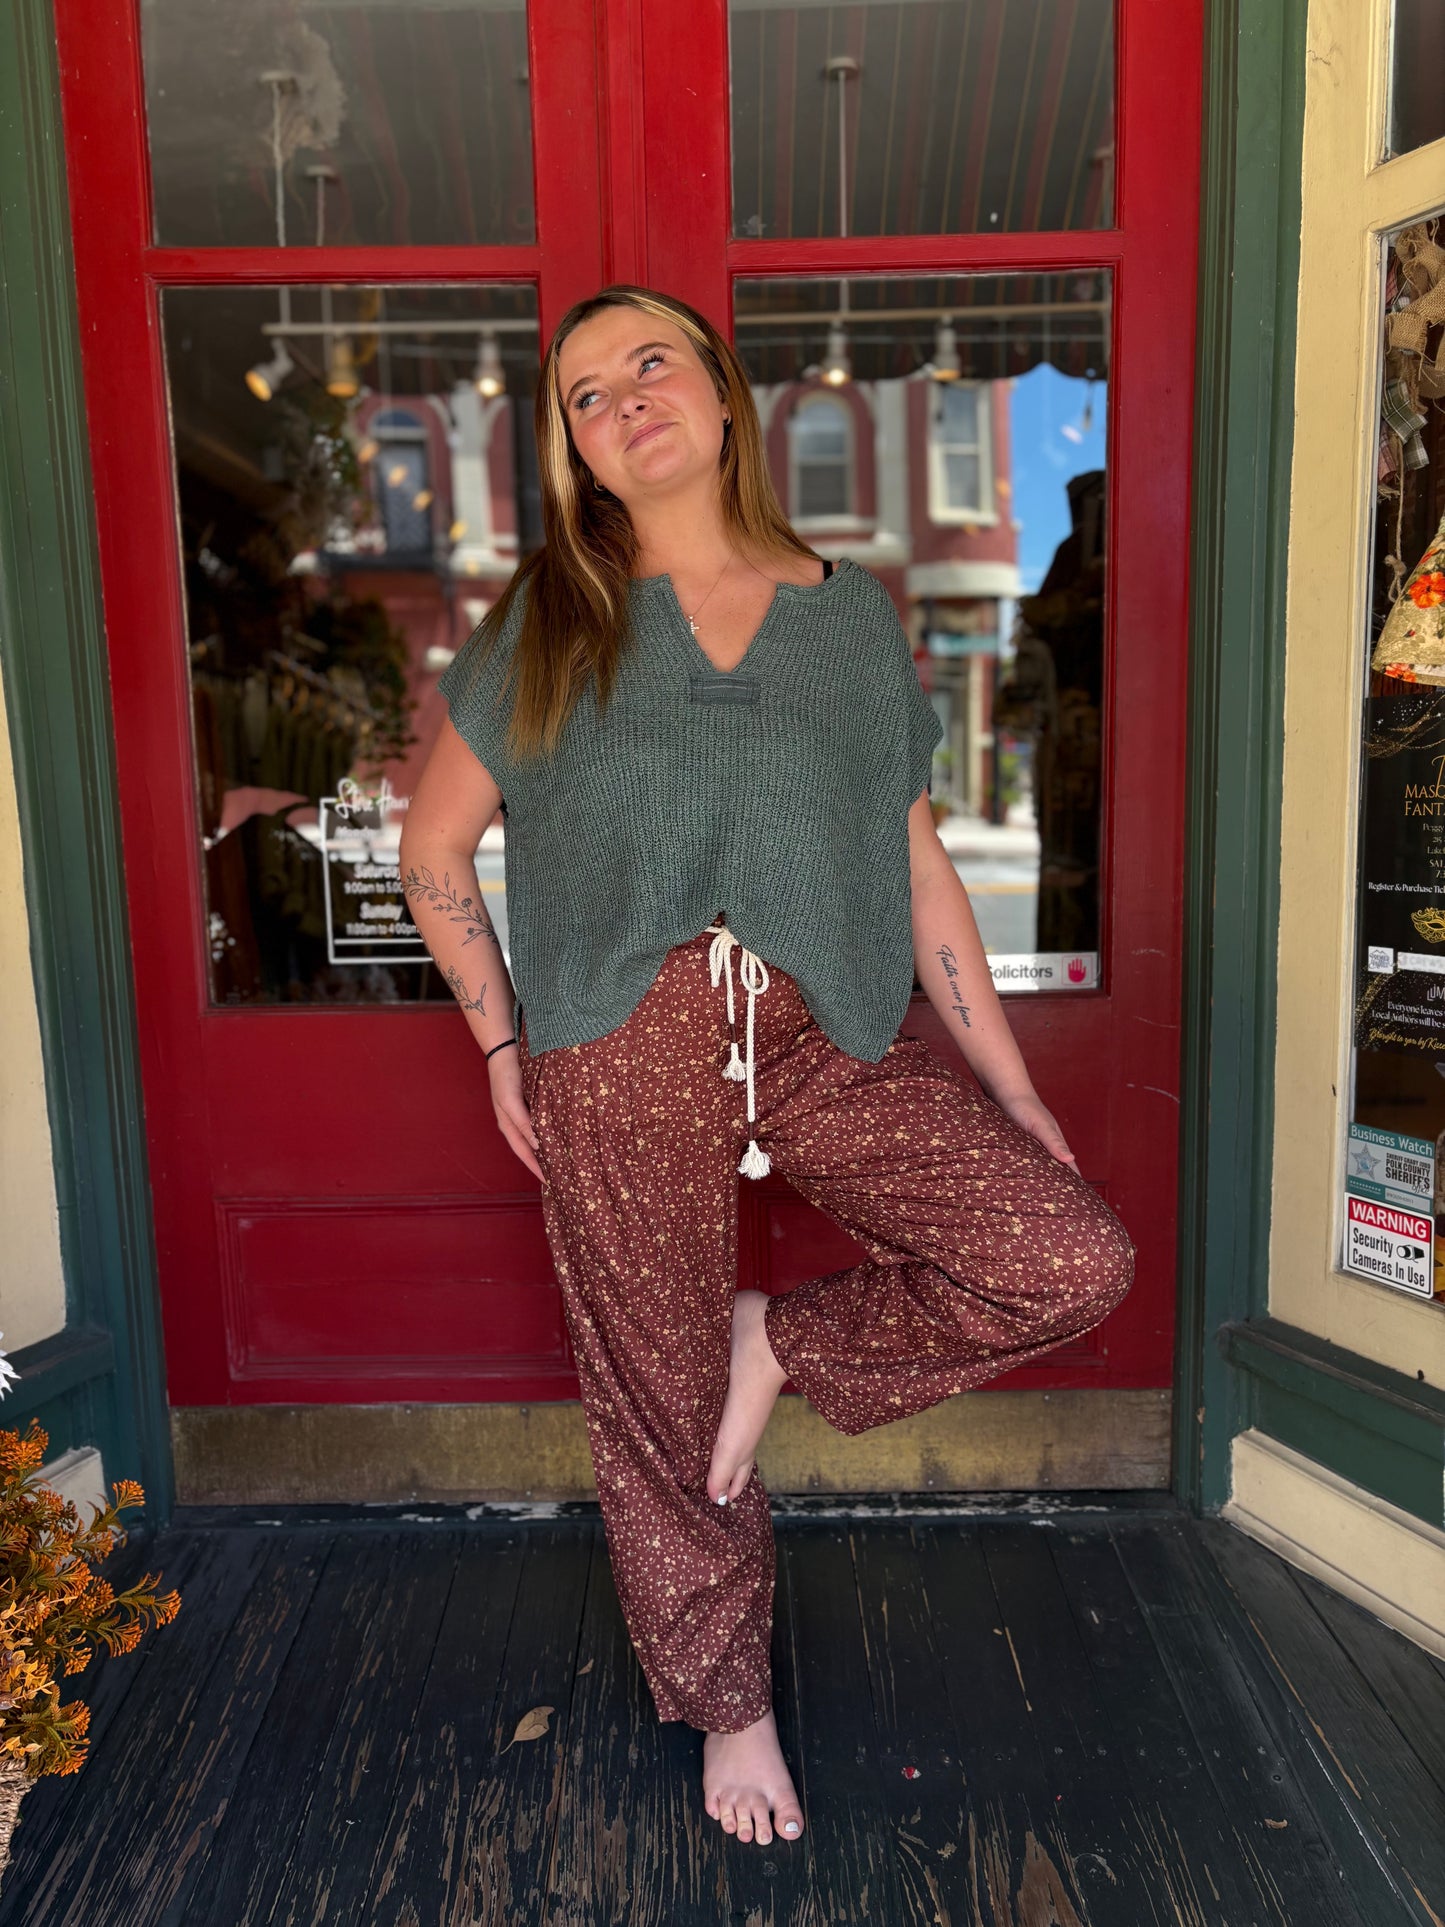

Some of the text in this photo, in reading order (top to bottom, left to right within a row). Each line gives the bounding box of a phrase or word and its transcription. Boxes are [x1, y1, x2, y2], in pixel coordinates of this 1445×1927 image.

[1405, 800, 1445, 816] FANT
[375, 882, 385, 894] to
[1368, 882, 1394, 892] Register
[1395, 883, 1402, 892] &
[1402, 884, 1433, 893] Purchase
[360, 901, 403, 920] Sunday
[378, 923, 387, 935] to
[936, 944, 971, 1028] Faith over fear
[1372, 1009, 1391, 1020] Local
[1391, 1012, 1419, 1024] Authors
[1419, 1017, 1431, 1026] will
[1431, 1018, 1442, 1028] be
[1387, 1001, 1443, 1017] Everyone leaves
[1396, 1034, 1404, 1042] to
[1351, 1125, 1433, 1157] Business Watch
[1386, 1159, 1430, 1177] POLK COUNTY
[1385, 1166, 1430, 1190] SHERIFF'S
[1352, 1201, 1427, 1239] WARNING
[1353, 1227, 1393, 1258] Security
[1353, 1248, 1425, 1287] Cameras In Use
